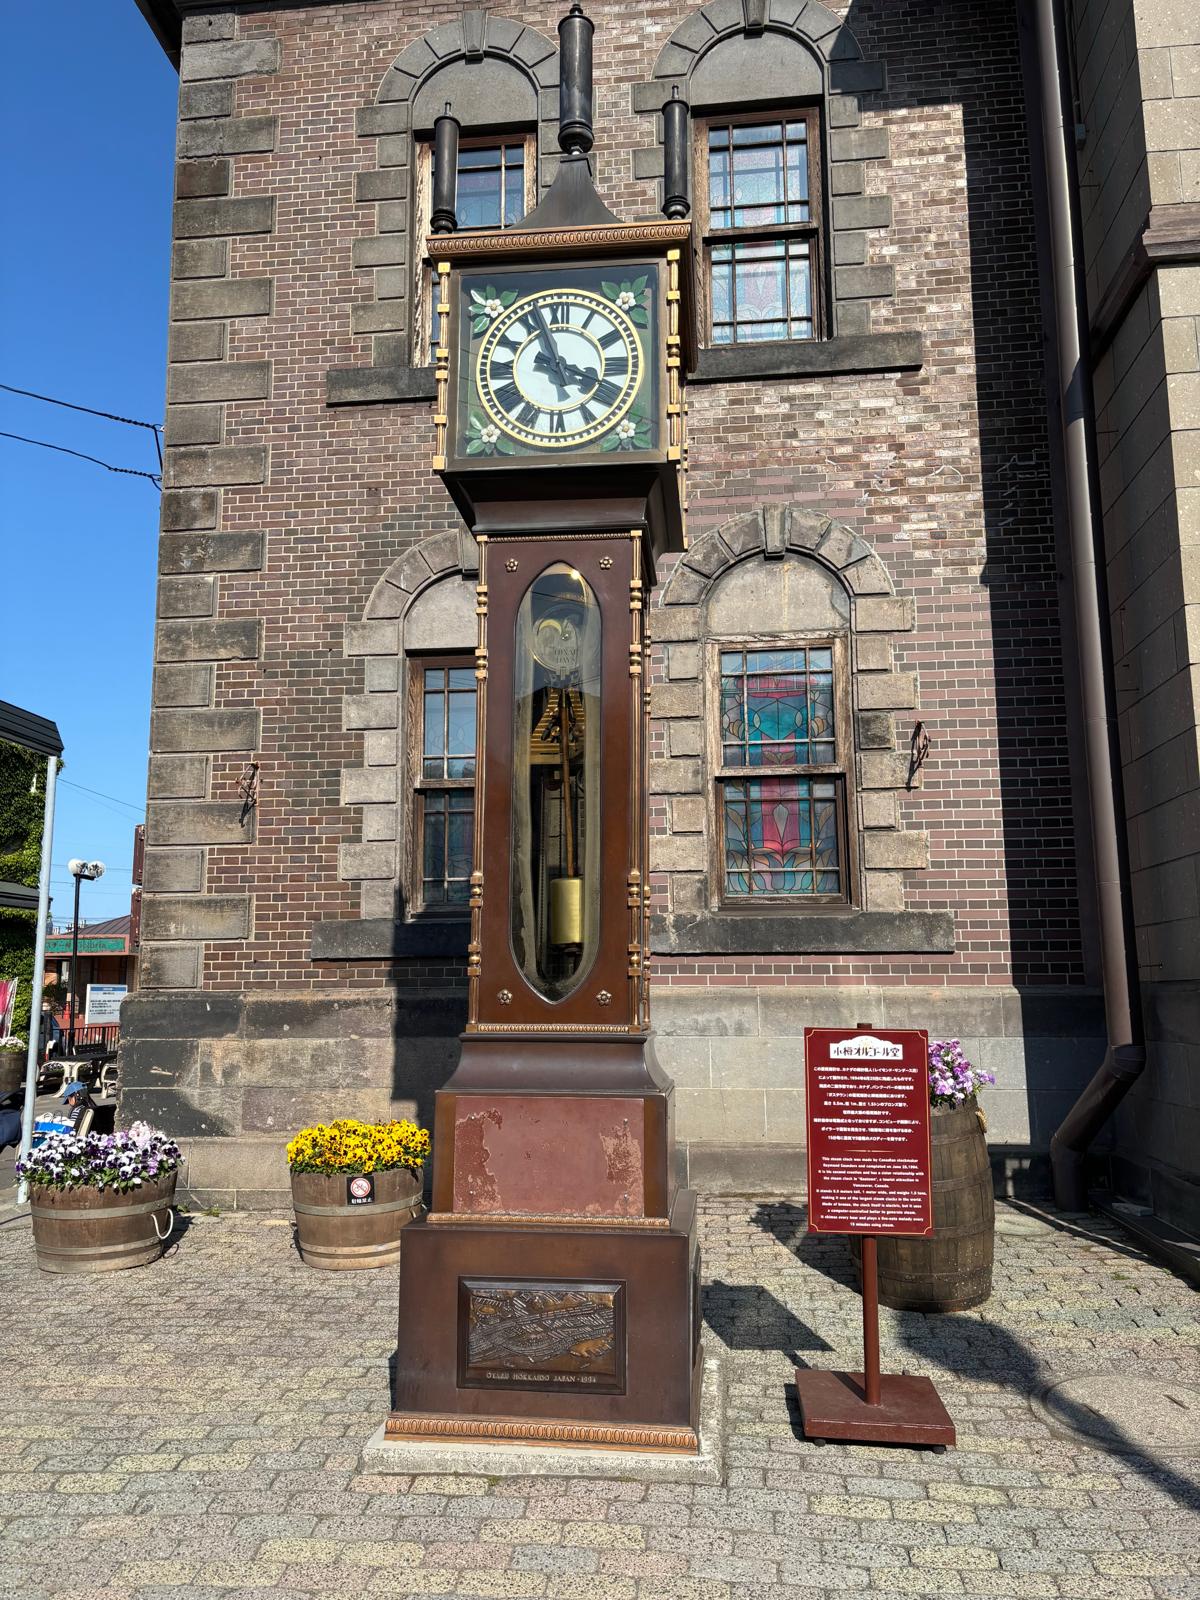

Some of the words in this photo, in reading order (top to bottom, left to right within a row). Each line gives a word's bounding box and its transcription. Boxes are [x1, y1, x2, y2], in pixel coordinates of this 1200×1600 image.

[550, 304, 570, 324] XII
[604, 356, 628, 377] III
[834, 1046, 900, 1058] 小樽オルゴール堂
[513, 1372, 550, 1382] HOKKAIDO
[554, 1374, 576, 1383] JAPAN
